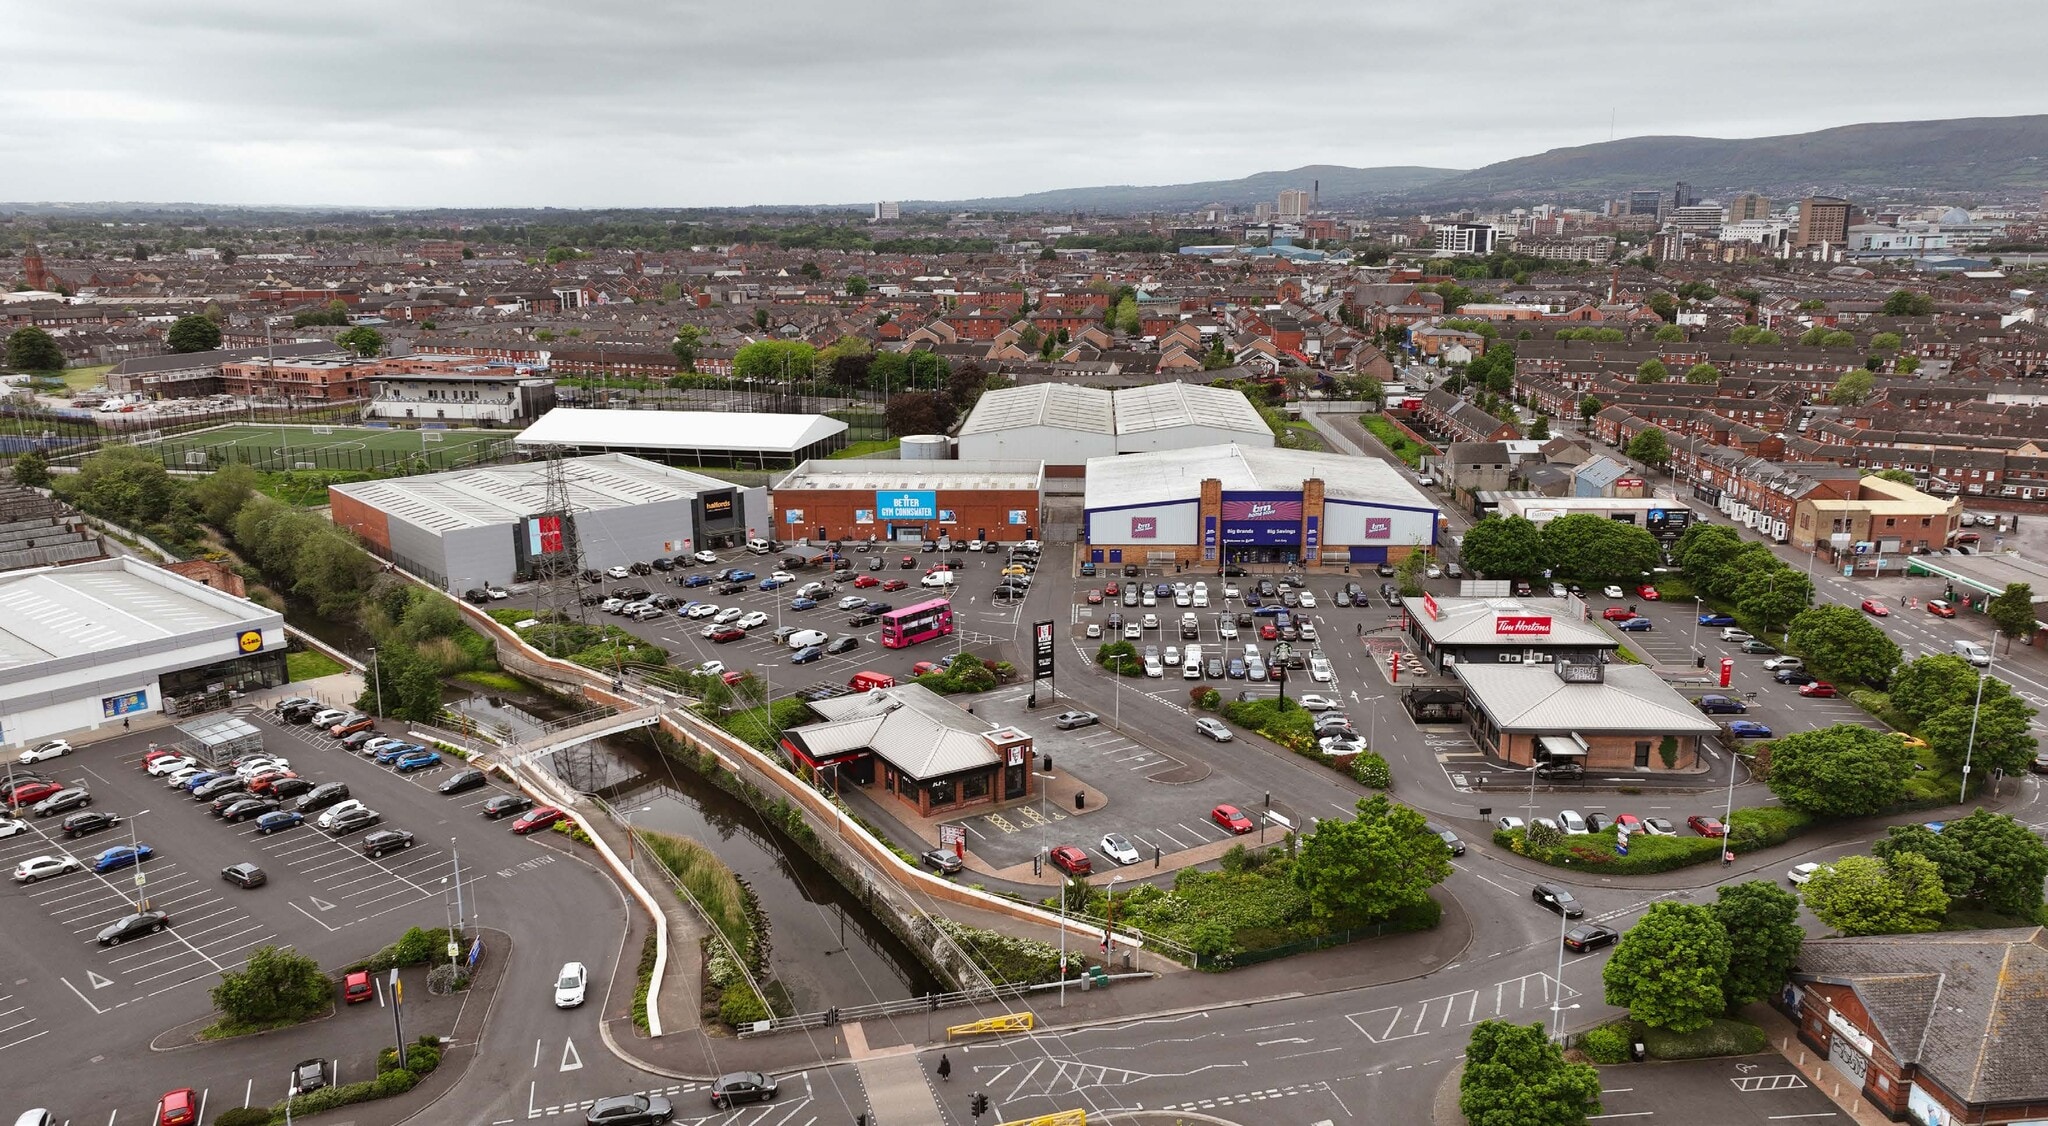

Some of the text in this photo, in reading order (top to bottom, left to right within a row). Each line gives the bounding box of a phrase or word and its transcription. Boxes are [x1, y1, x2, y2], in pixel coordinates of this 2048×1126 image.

[706, 500, 731, 510] halfords
[893, 496, 920, 507] BETTER
[881, 507, 933, 516] GYM CONNSWATER
[1498, 620, 1549, 631] Tim Hortons
[496, 855, 556, 878] NO ENTRY
